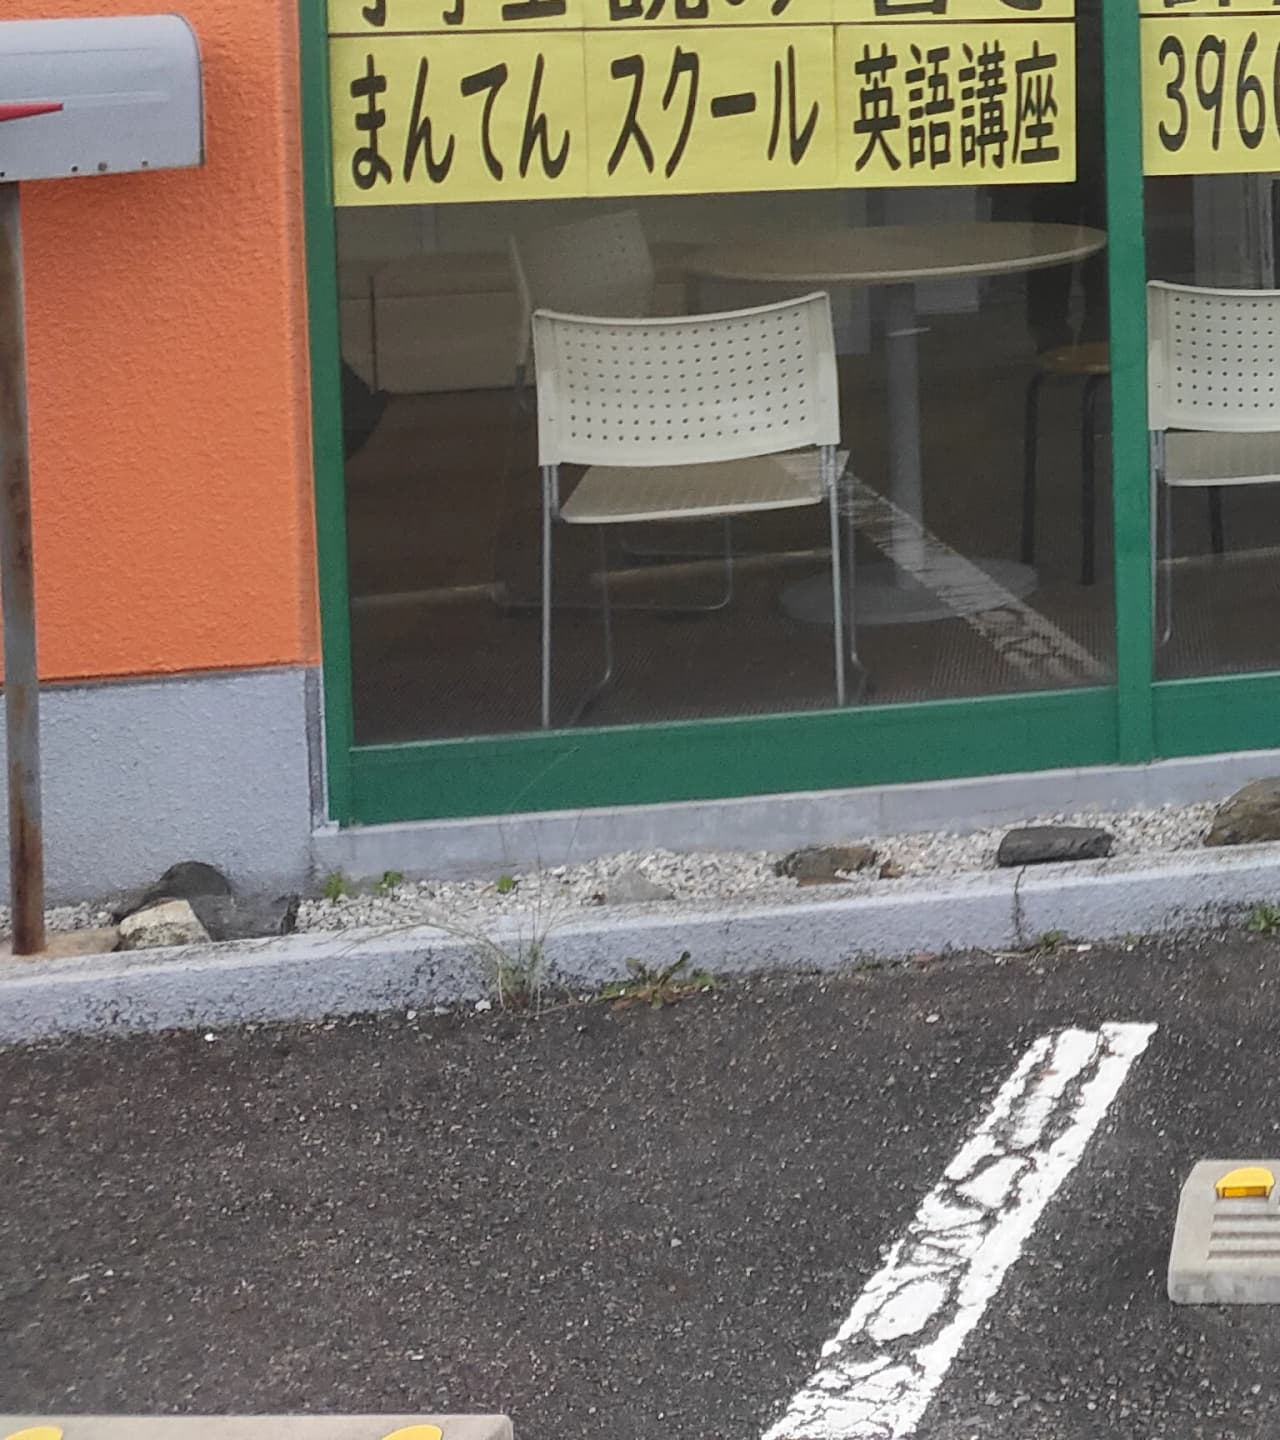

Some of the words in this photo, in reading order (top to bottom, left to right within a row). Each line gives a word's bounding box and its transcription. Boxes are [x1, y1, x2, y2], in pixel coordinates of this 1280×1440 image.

[350, 53, 571, 191] まんてん
[606, 44, 820, 179] スクール
[852, 40, 1060, 172] 英語講座
